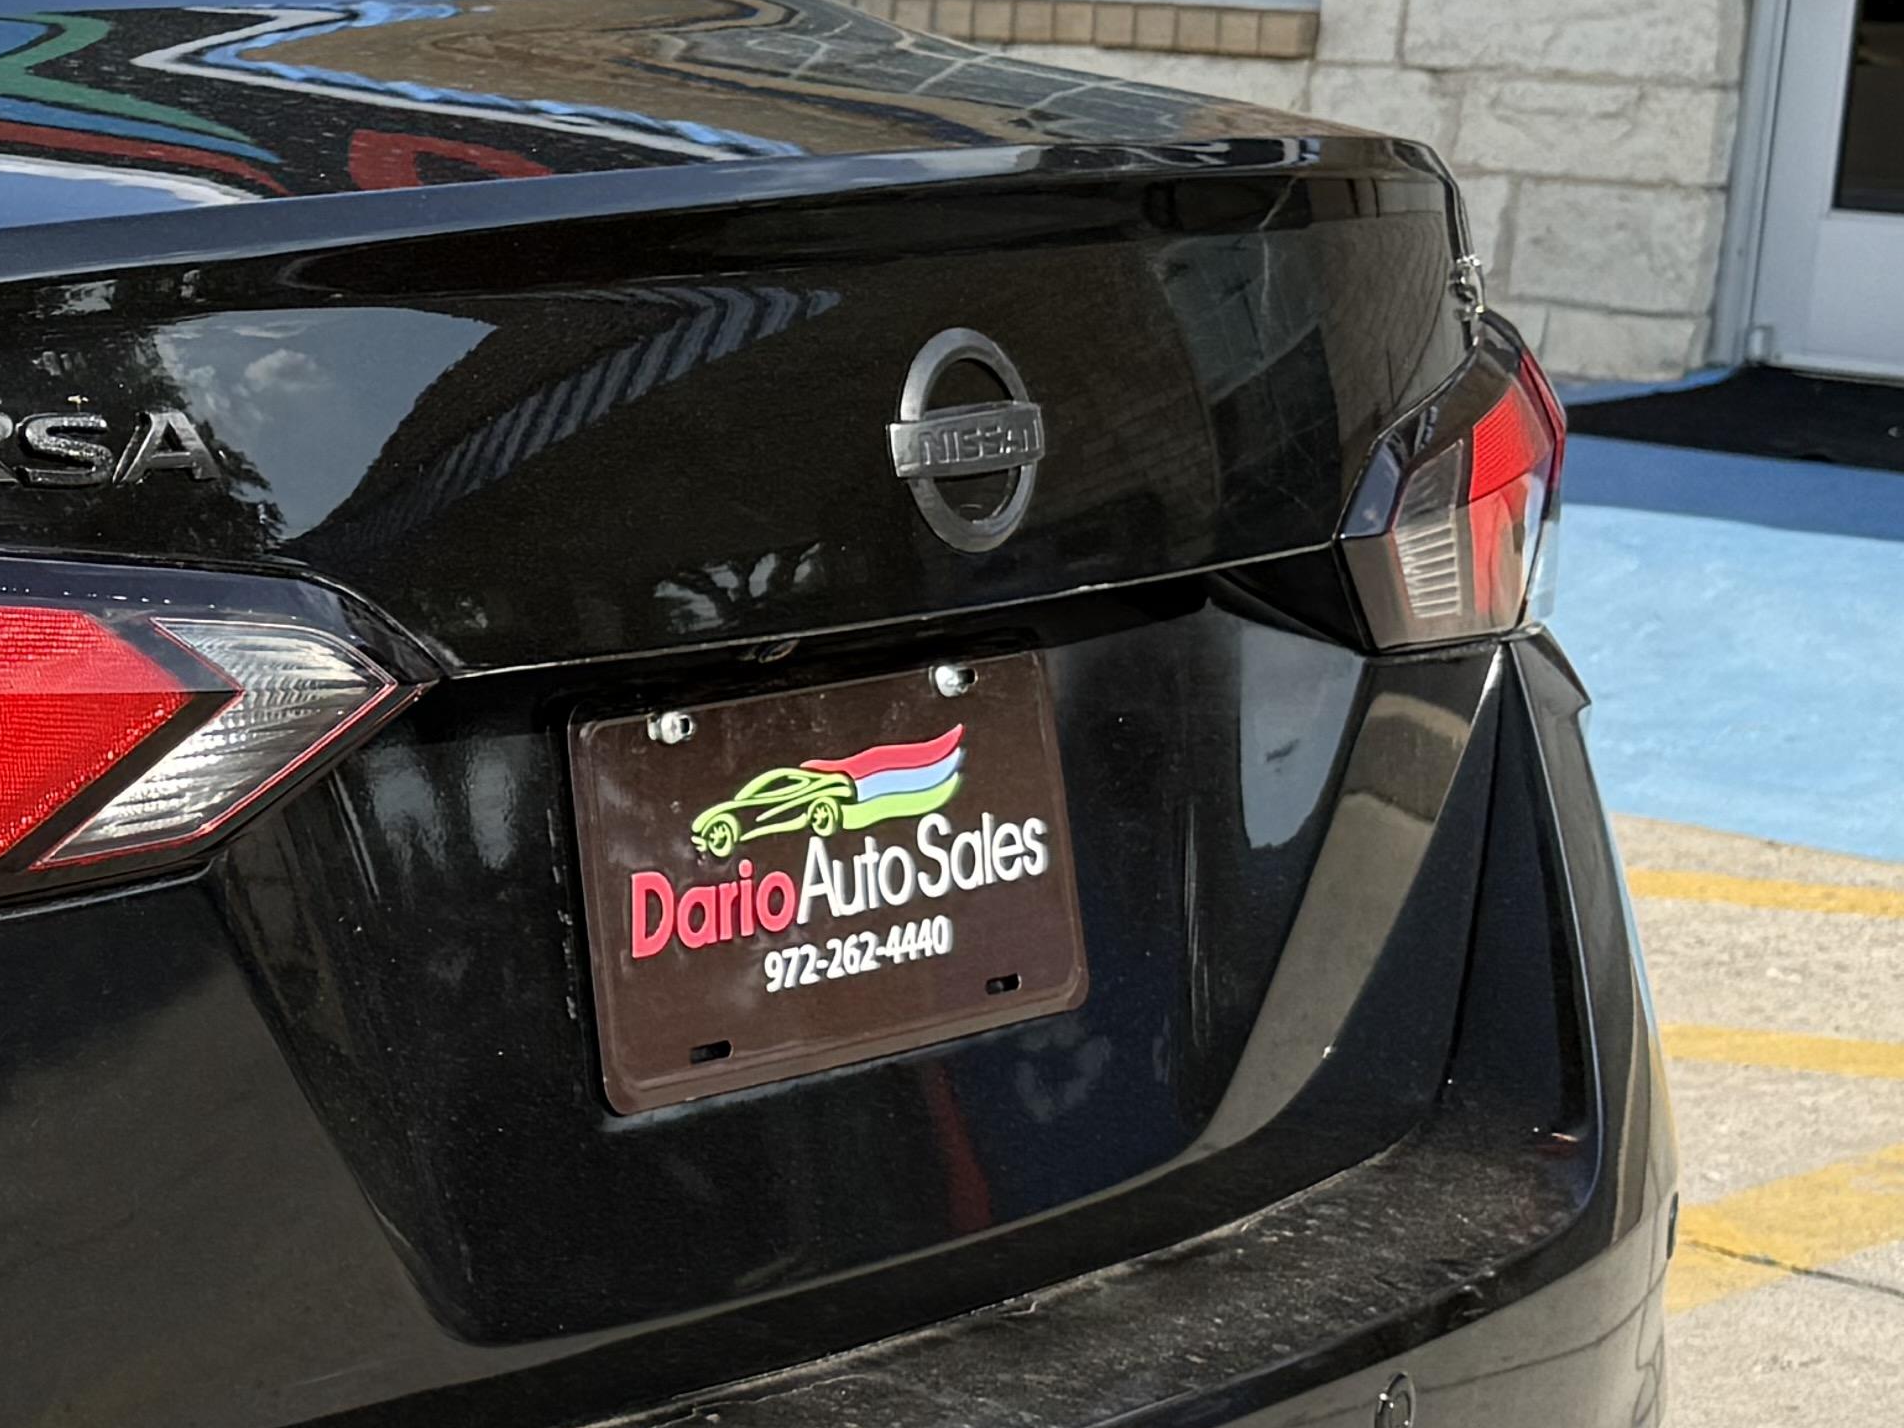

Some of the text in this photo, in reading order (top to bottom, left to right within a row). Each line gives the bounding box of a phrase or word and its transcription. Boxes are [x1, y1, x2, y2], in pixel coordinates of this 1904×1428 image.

[918, 419, 1041, 465] NISSAN
[631, 812, 1046, 958] Dario Auto Sales
[764, 915, 950, 992] 972-262-4440
